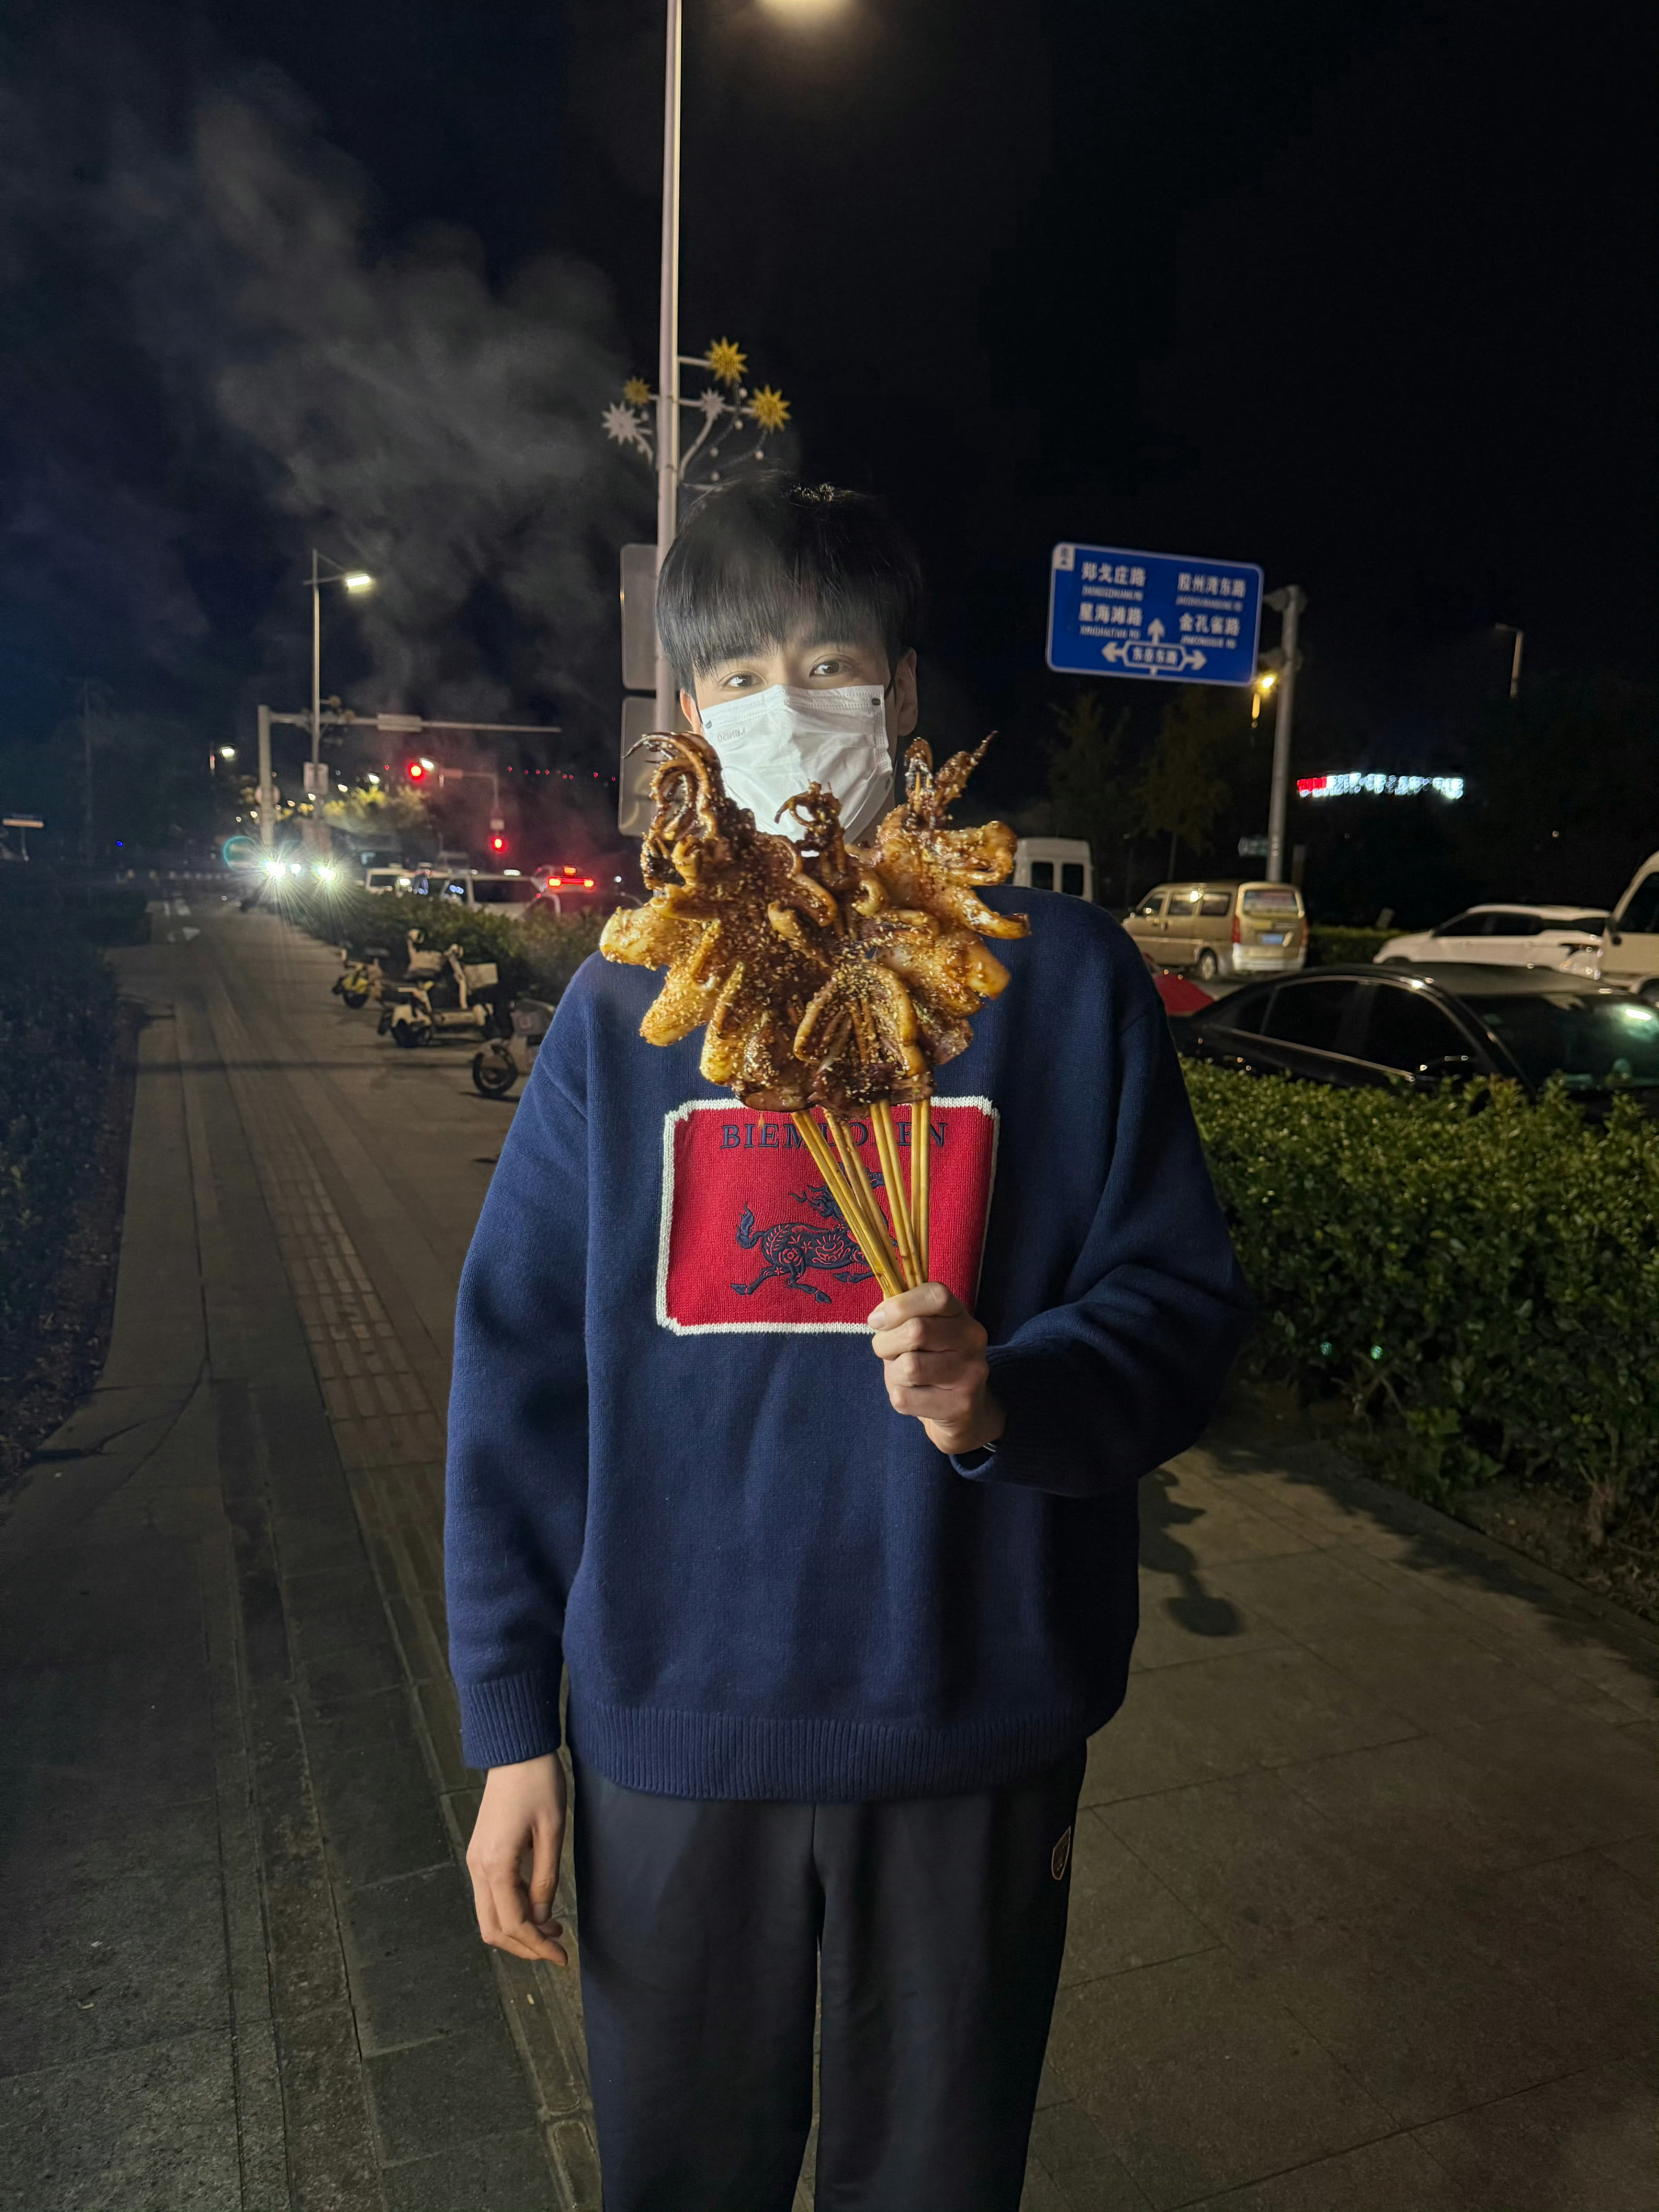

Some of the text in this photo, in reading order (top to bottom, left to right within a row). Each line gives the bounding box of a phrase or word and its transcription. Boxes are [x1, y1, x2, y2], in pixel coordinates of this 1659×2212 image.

[1178, 572, 1247, 598] 胶州湾东路
[1180, 612, 1240, 637] 金孔雀路
[720, 1122, 948, 1148] BIEMLOEN
